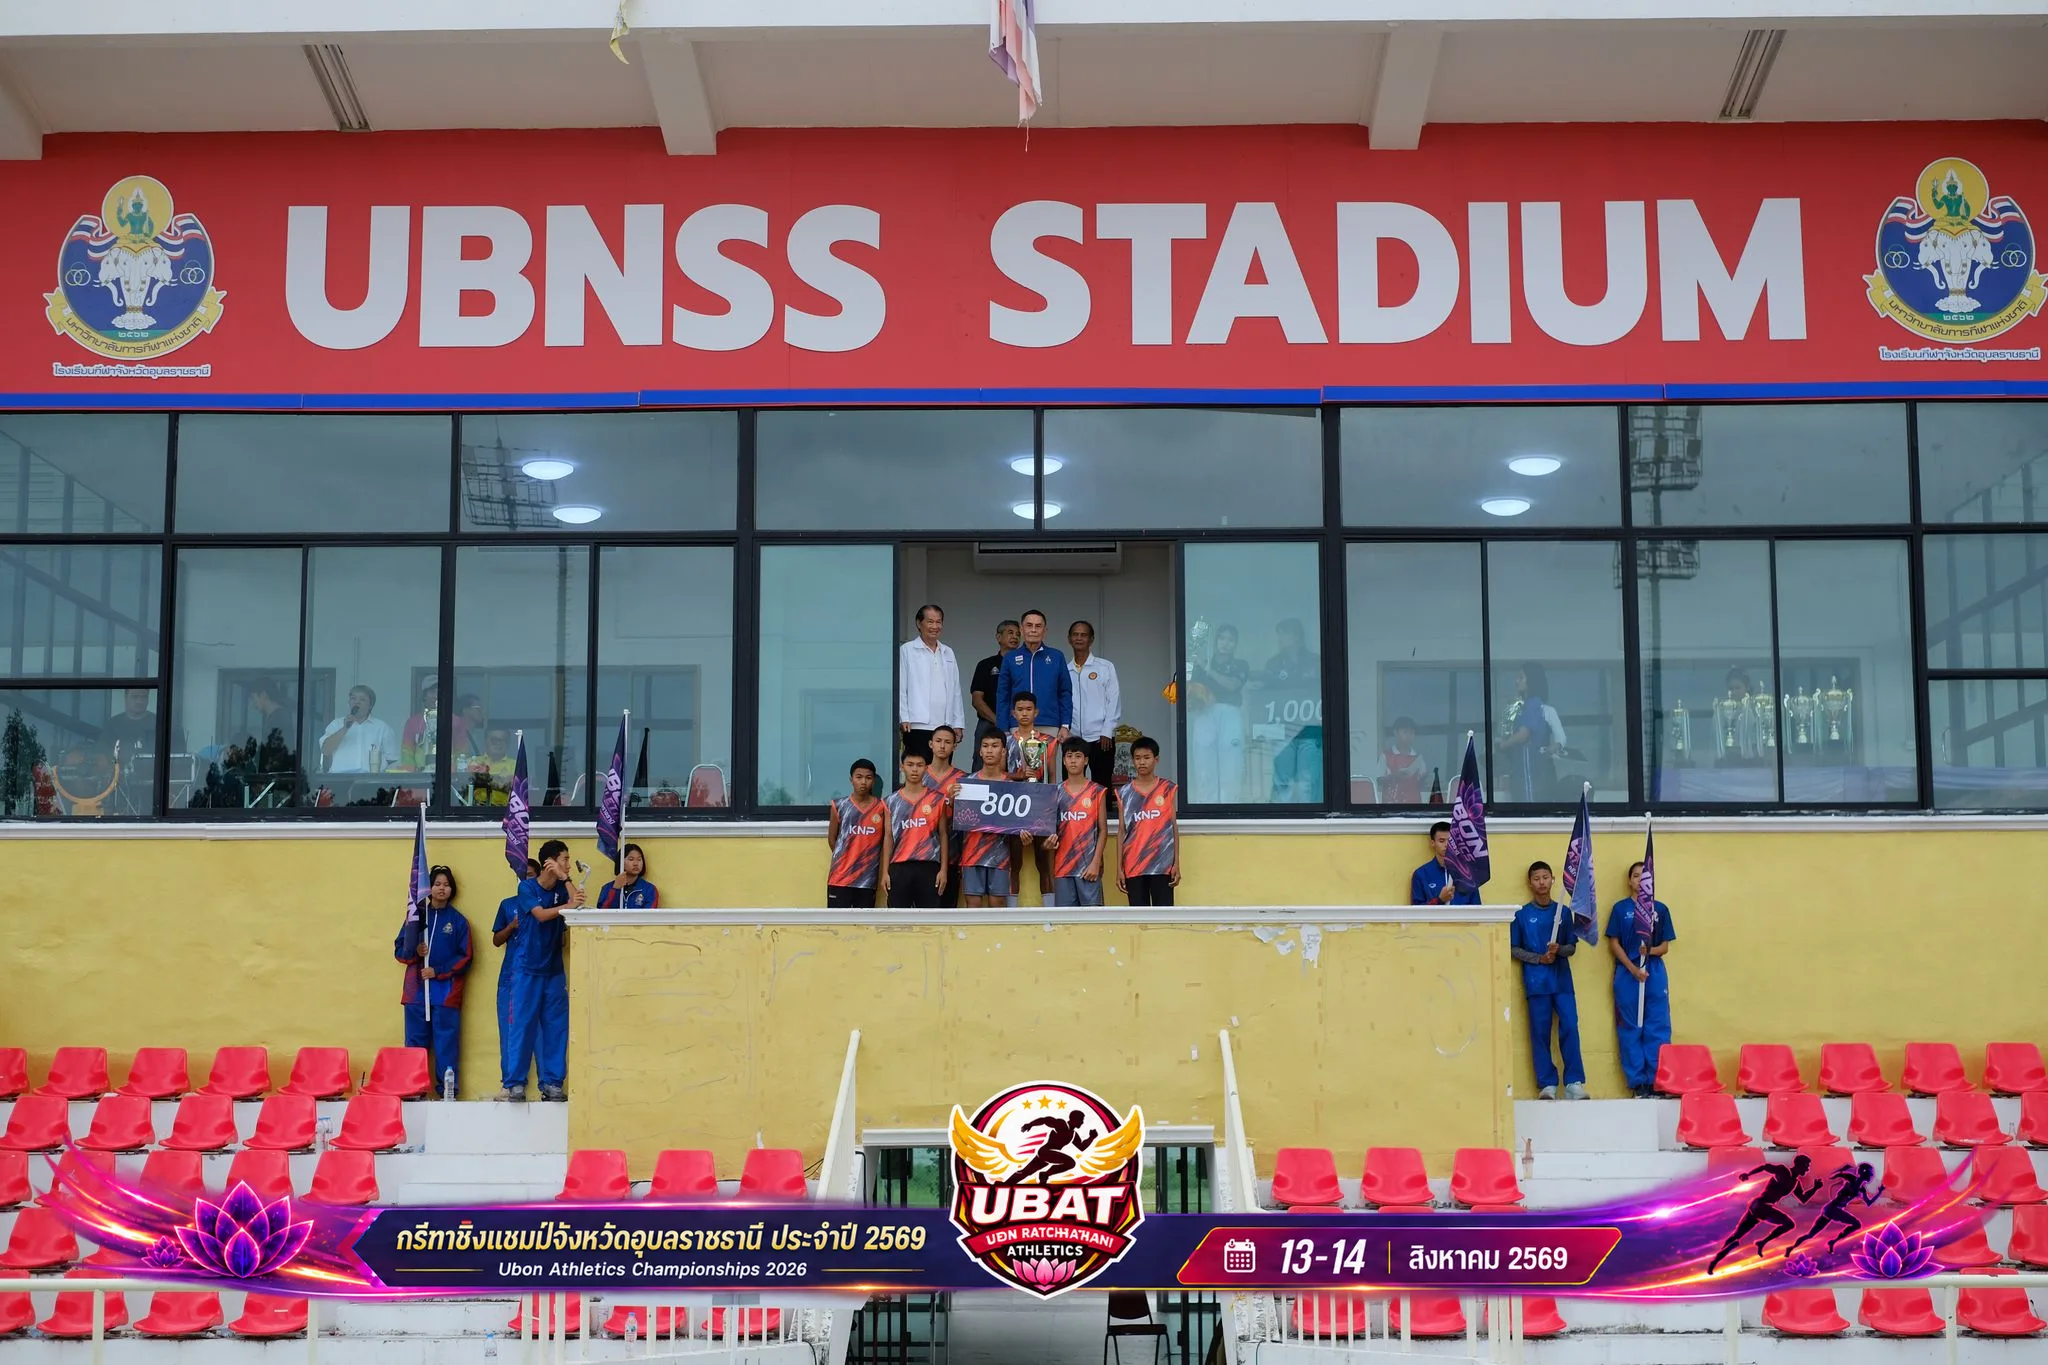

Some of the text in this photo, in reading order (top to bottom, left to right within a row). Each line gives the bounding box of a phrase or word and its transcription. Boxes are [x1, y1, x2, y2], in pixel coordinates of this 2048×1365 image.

[285, 198, 1807, 353] UBNSS STADIUM
[980, 793, 1032, 818] 800
[1060, 810, 1088, 822] KNP
[1133, 810, 1161, 822] KNP
[902, 817, 927, 830] KNP
[849, 825, 876, 836] KNP
